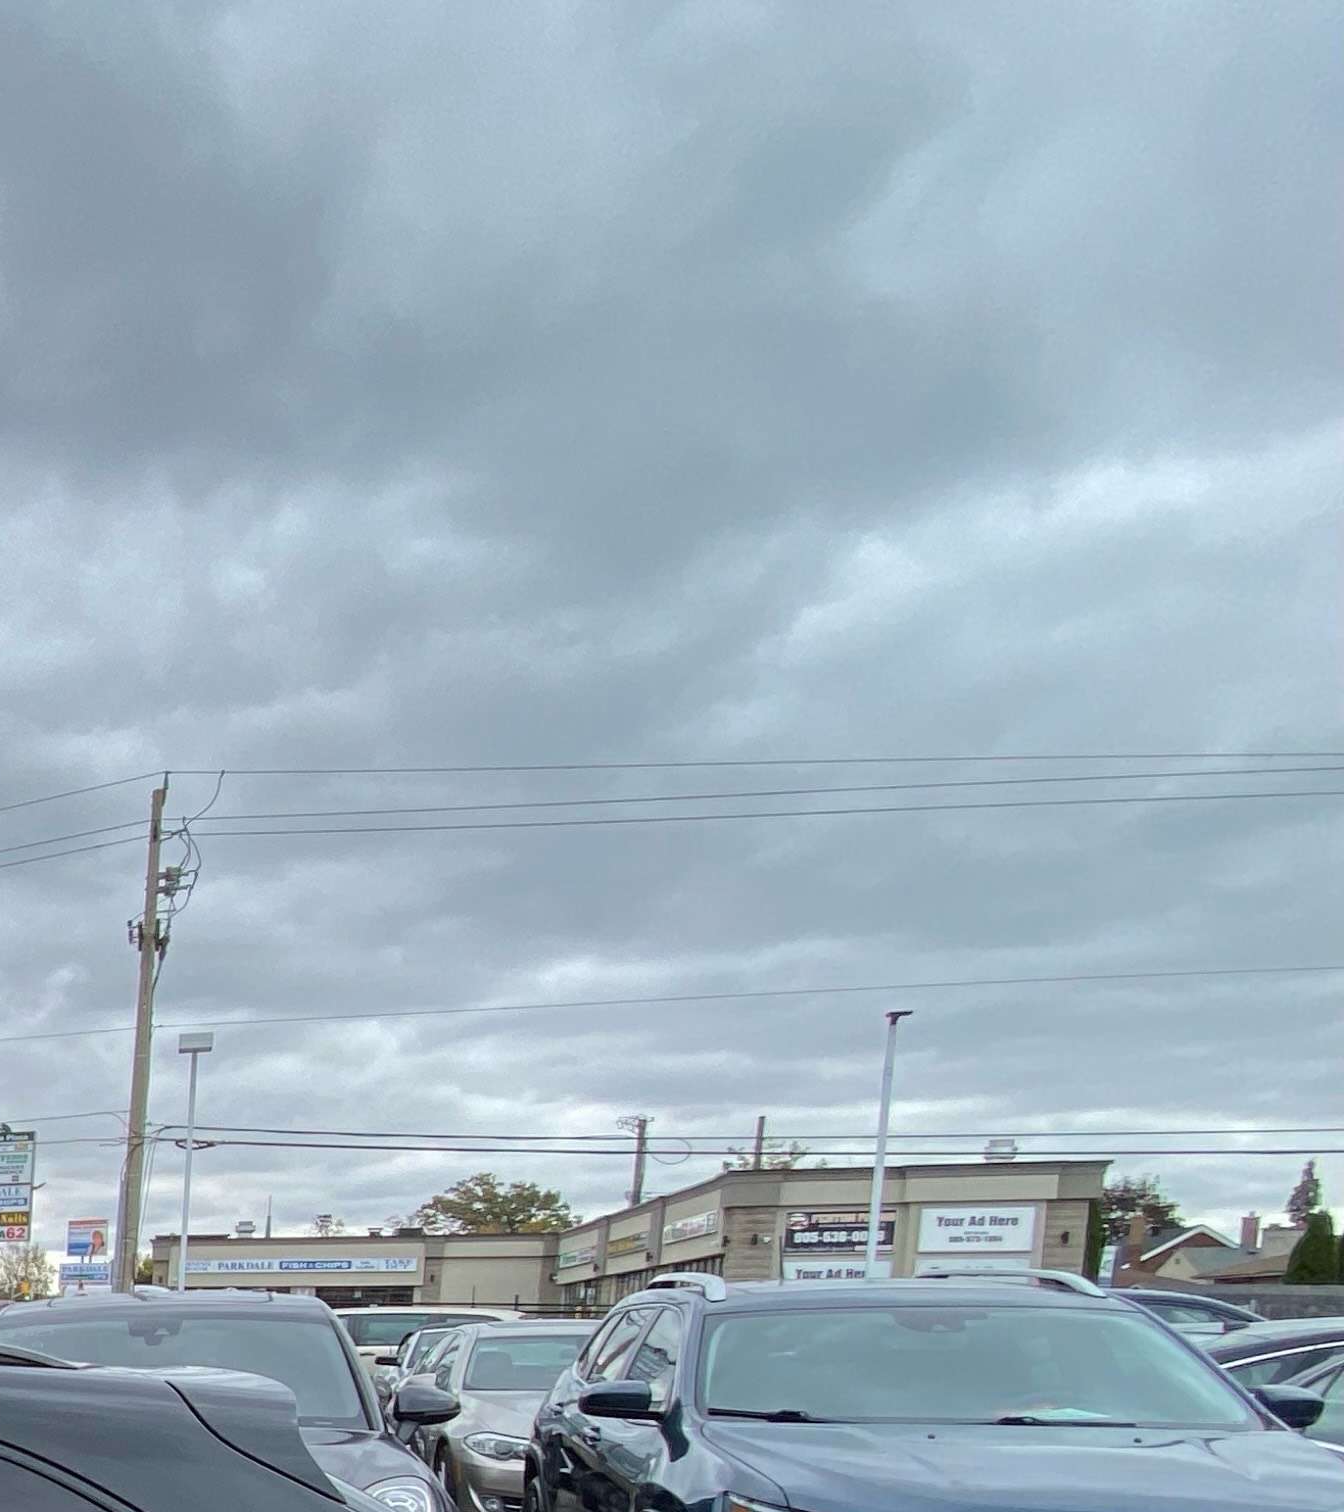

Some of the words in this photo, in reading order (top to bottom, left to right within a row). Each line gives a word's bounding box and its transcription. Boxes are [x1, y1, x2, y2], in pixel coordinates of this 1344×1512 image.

[936, 1216, 965, 1227] Your
[968, 1215, 986, 1227] Ad
[989, 1215, 1019, 1226] Here
[6, 1227, 26, 1240] 62
[217, 1260, 273, 1271] PARKDALE
[796, 1268, 824, 1280] Your
[826, 1268, 842, 1280] Ad
